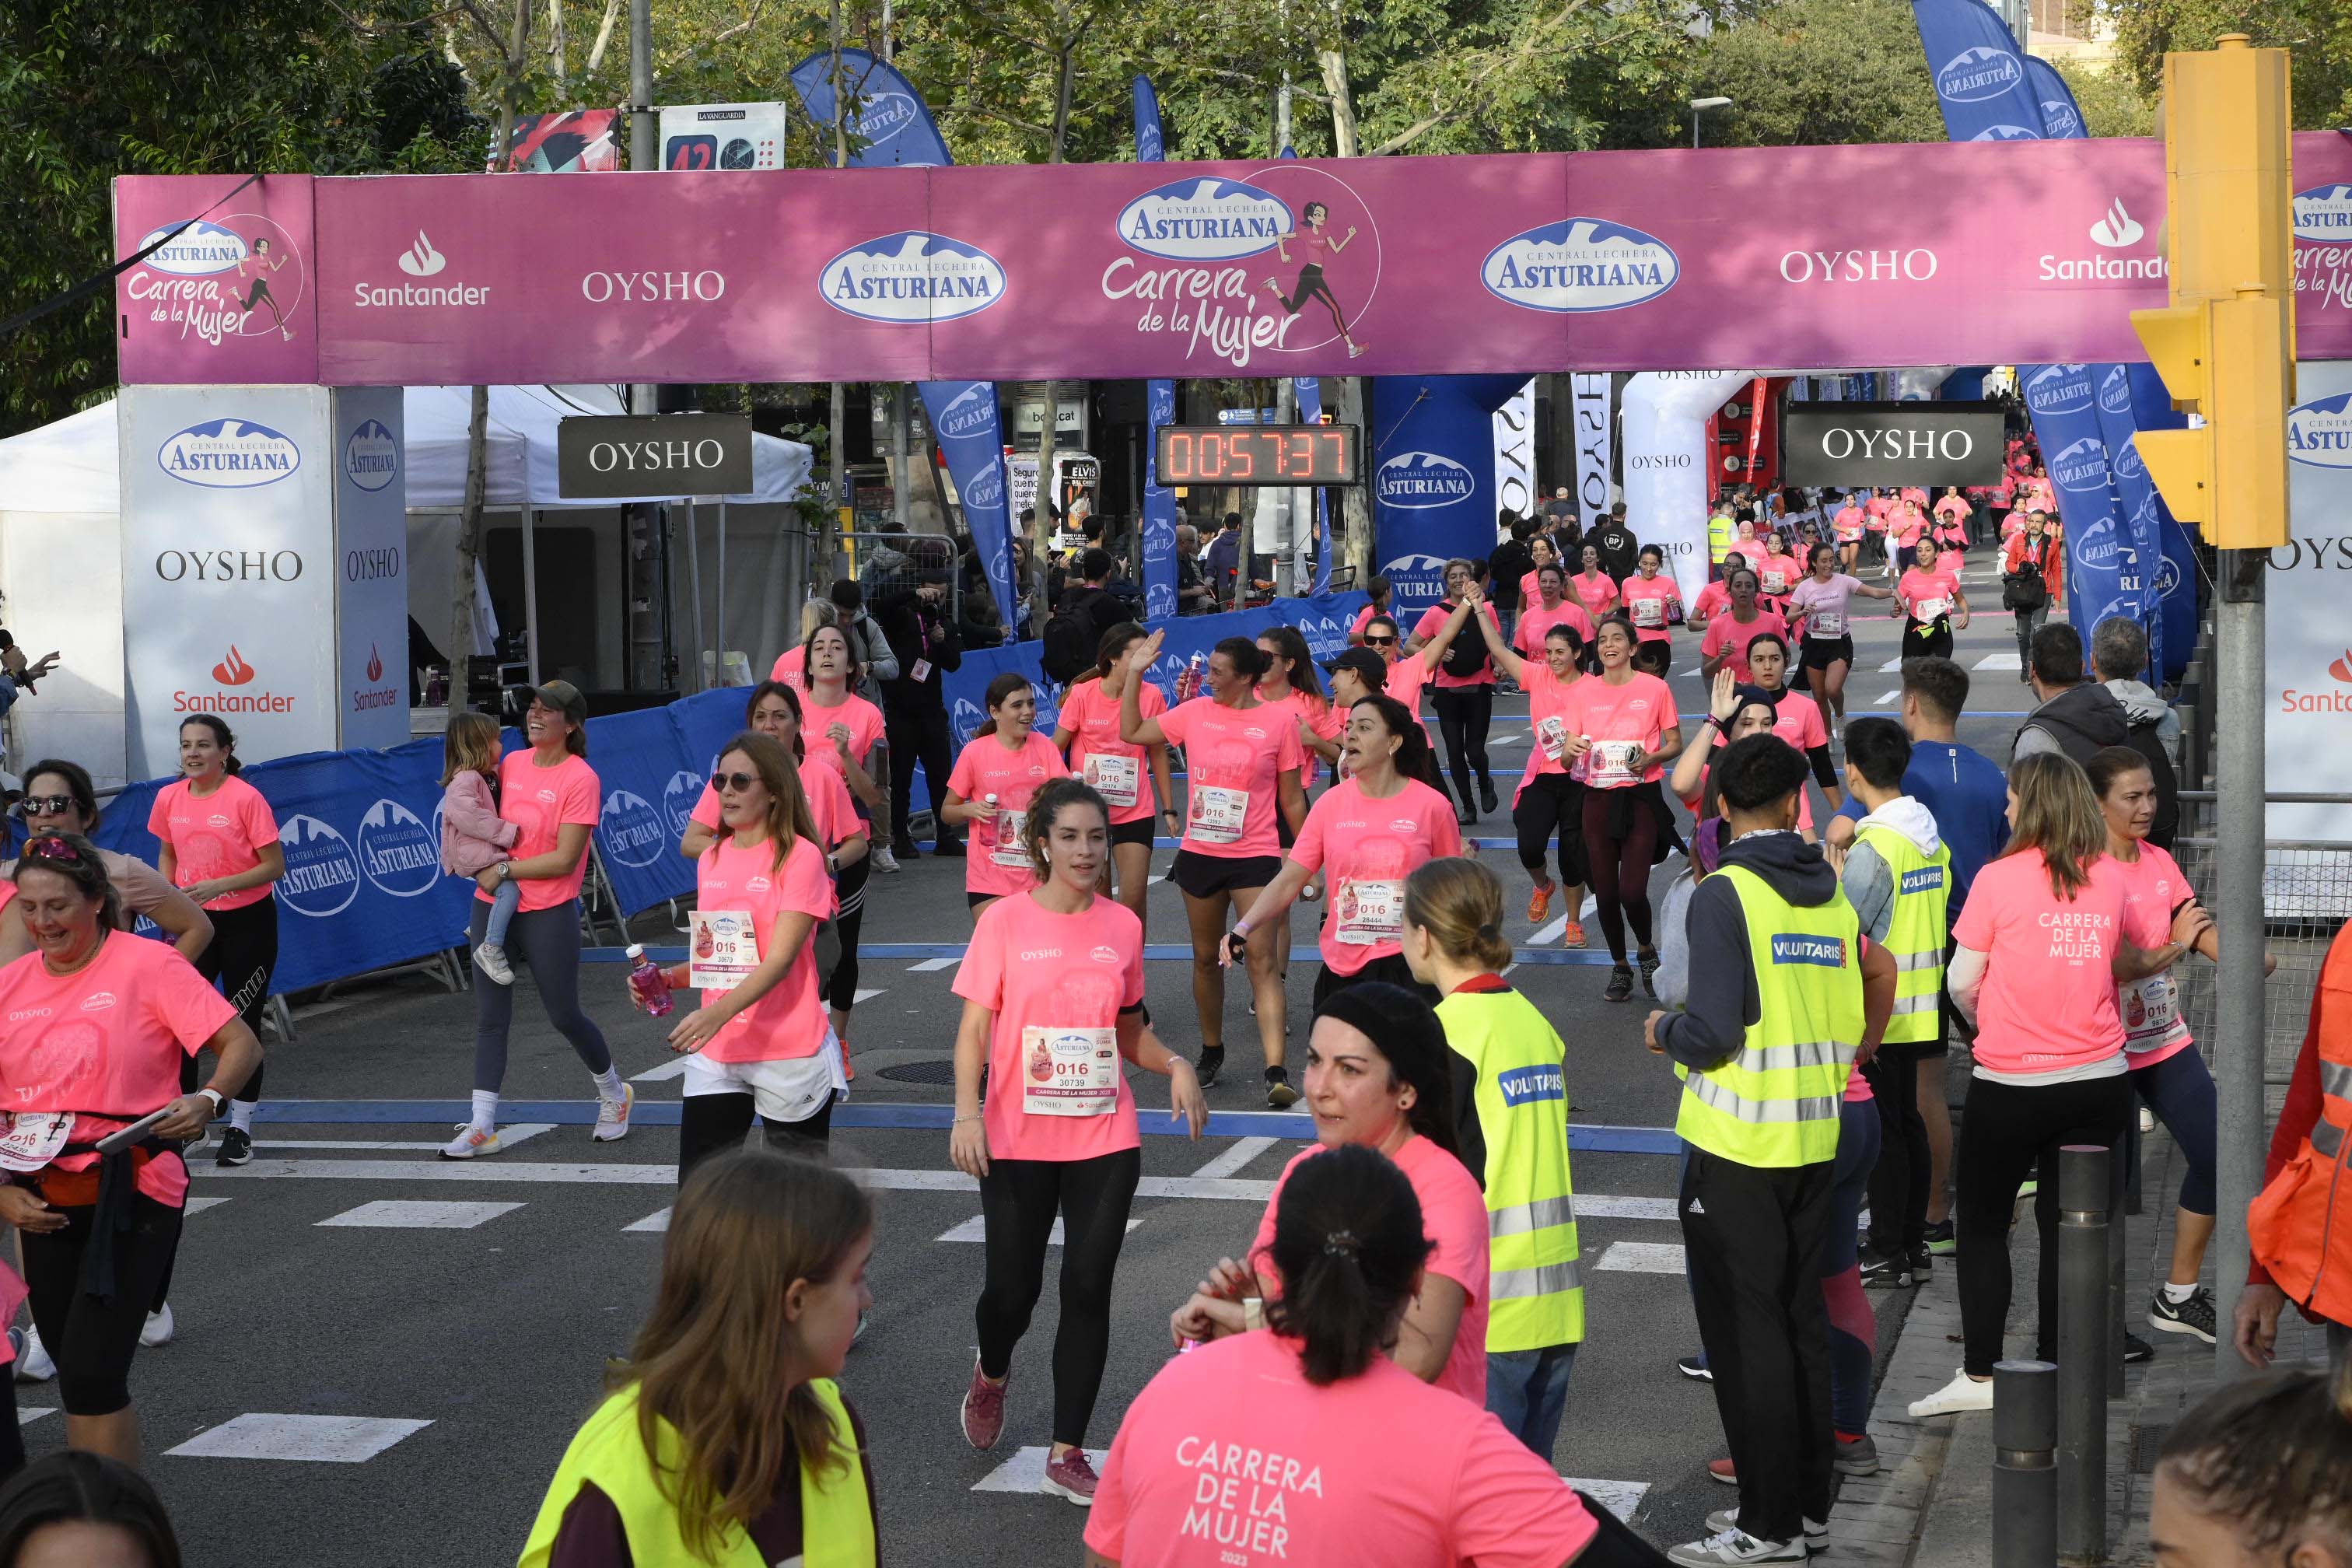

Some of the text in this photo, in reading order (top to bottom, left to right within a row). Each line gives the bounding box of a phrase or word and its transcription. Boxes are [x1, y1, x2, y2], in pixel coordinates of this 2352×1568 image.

[707, 110, 744, 120] VANGUARDIA
[1157, 204, 1275, 214] CENTRAL LECHERA
[2293, 206, 2352, 227] STUR
[1129, 208, 1279, 240] ASTURIANA
[1527, 248, 1657, 261] CENTRAL LECHERA
[1780, 249, 1937, 282] OYSHO
[2294, 247, 2352, 269] arrer
[862, 262, 985, 272] CENTRAL LECHERA
[1496, 254, 1664, 289] ASTURIANA
[2039, 254, 2168, 281] Santand
[128, 271, 219, 300] Carrera
[582, 271, 725, 302] OYSHO
[834, 265, 992, 299] ASTURIANA
[1101, 257, 1248, 300] Carrera
[2311, 269, 2325, 291] la
[355, 282, 490, 306] Santander
[150, 299, 254, 345] de la Mujer
[1138, 293, 1301, 368] de la Mujer
[1822, 428, 1972, 460] OYSHO
[2288, 422, 2352, 450] ASTU
[170, 444, 290, 471] ASTURIANA
[350, 446, 394, 474] ASTURIANA
[589, 439, 723, 471] OYSHO
[1170, 434, 1343, 477] 00:57:37
[1632, 453, 1691, 469] OYSHO
[1073, 467, 1096, 477] ELVIS
[1014, 480, 1027, 489] que
[1380, 474, 1467, 496] ASTURIANA
[348, 547, 398, 581] OYSHO
[2266, 537, 2352, 570] OYS
[156, 550, 303, 581] OYSHO
[1396, 583, 1444, 597] TURIA
[173, 691, 295, 712] Santander
[355, 688, 397, 712] Santander
[2282, 689, 2352, 713] Santa
[1206, 808, 1224, 817] 016
[373, 829, 425, 844] CENTRAL LECHERA
[287, 843, 345, 863] CENTRAL LECHERA
[366, 839, 436, 876] ASTURIANA
[282, 857, 356, 896] ASTURIANA
[1902, 872, 1942, 890] VOLUNTARIS
[1360, 905, 1386, 915] 016
[2039, 912, 2111, 929] CARRERA
[2053, 929, 2099, 943] DE LA
[716, 942, 736, 954] 016
[1020, 948, 1062, 961] OYSHO
[1774, 942, 1840, 961] VOLUNTARIS
[2049, 943, 2102, 959] MUJER
[9, 1008, 52, 1021] OYSHO
[2148, 1003, 2167, 1017] 016
[1054, 1042, 1090, 1051] ASTURIANA
[1056, 1062, 1089, 1075] 016
[1503, 1074, 1563, 1097] VOLUNTARIS
[1033, 1101, 1062, 1109] OYSHO
[9, 1133, 37, 1146] 016
[1176, 1436, 1323, 1498] CARRERA
[1195, 1473, 1287, 1524] DE LA
[1181, 1505, 1290, 1559] MUJER
[1220, 1550, 1248, 1567] 2023
